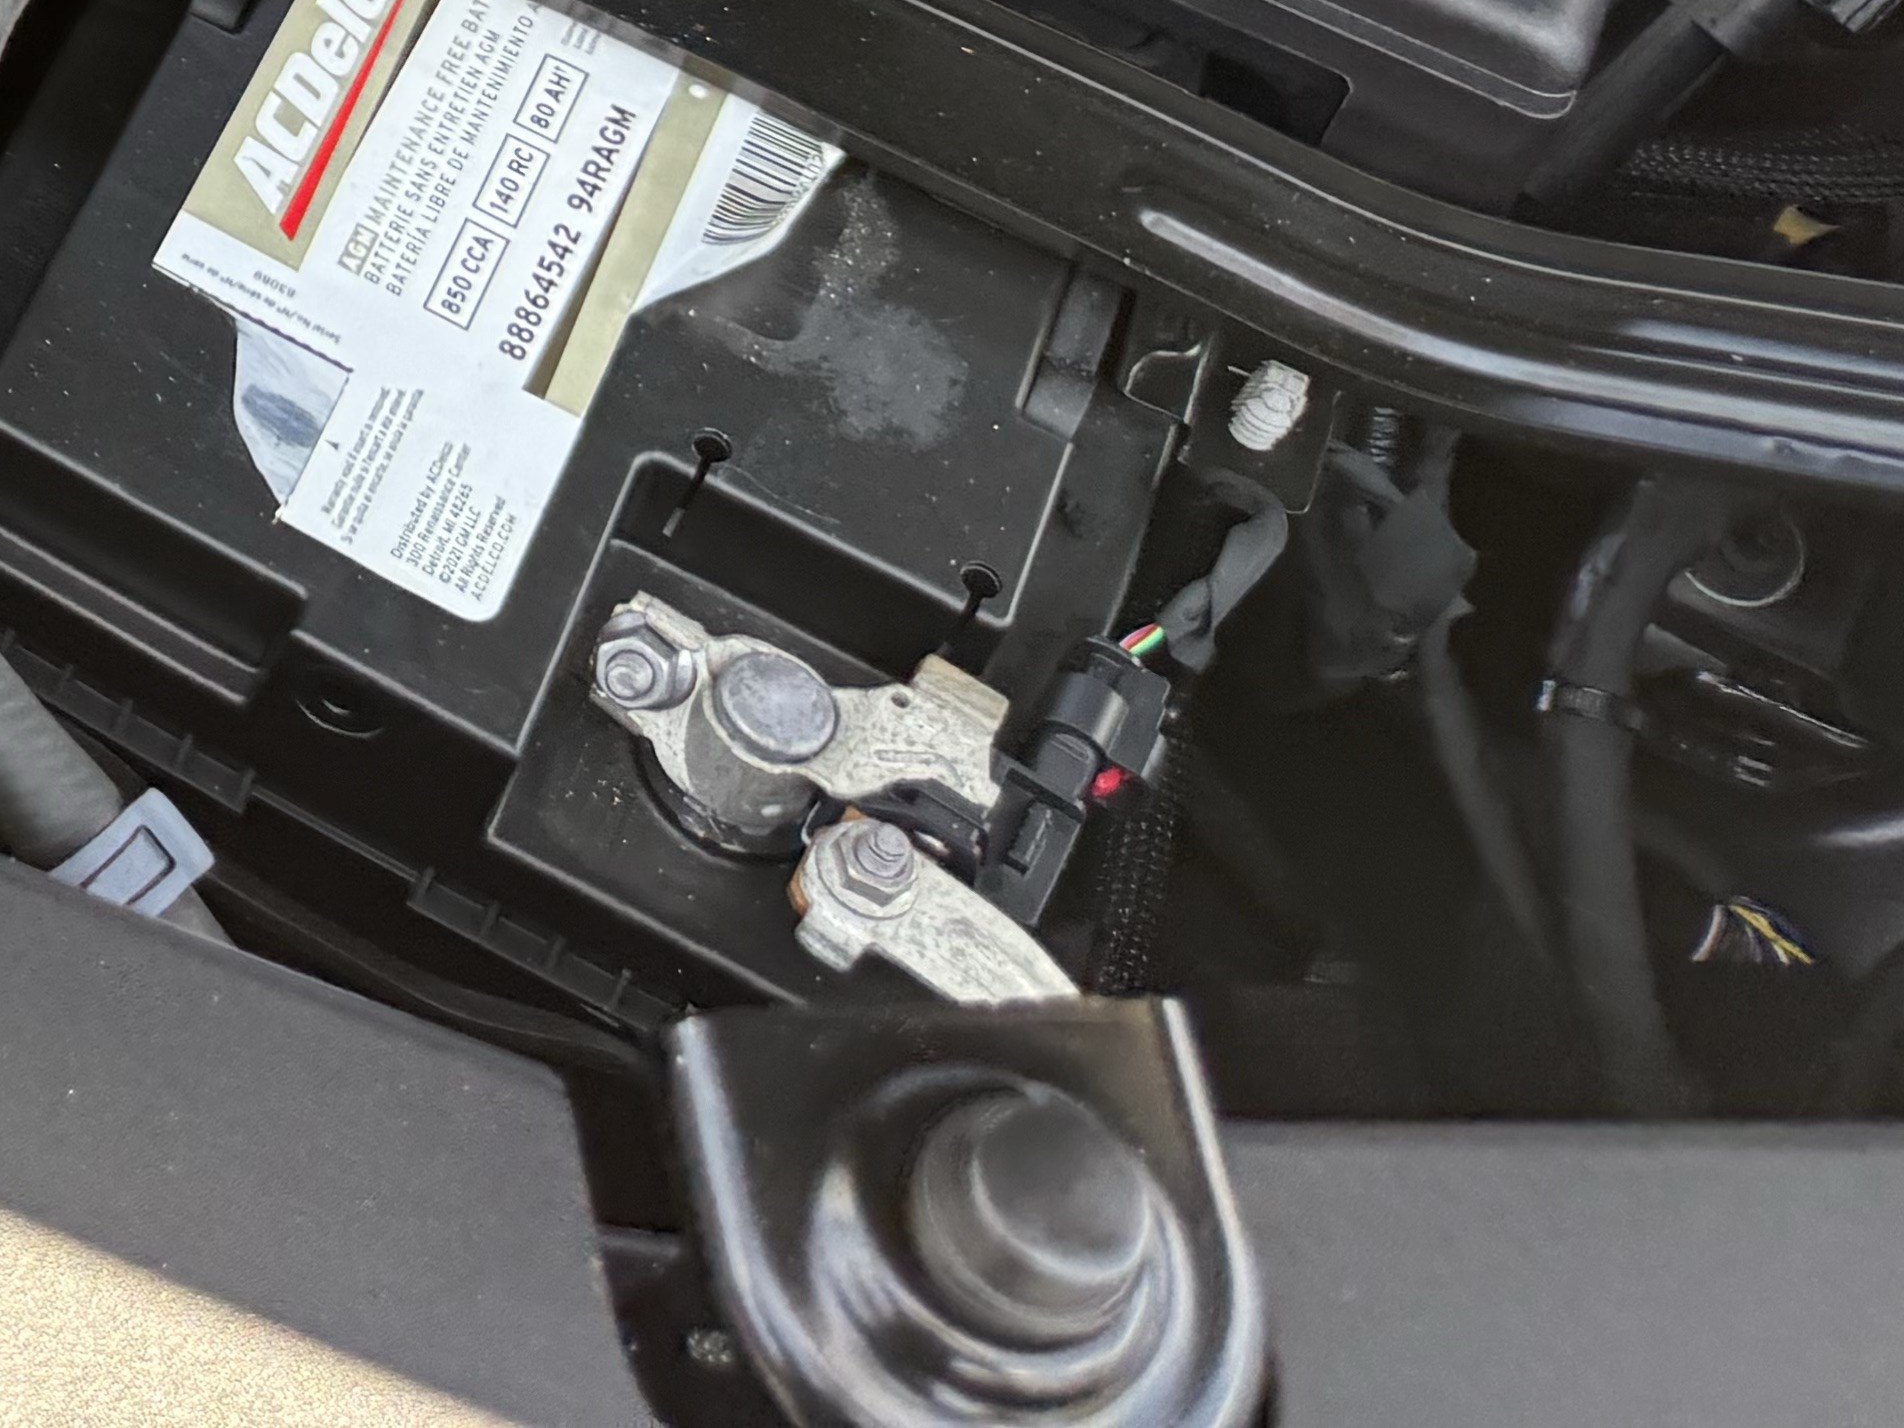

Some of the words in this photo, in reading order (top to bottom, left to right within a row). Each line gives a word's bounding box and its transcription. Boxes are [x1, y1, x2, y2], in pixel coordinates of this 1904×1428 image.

[530, 100, 556, 131] 80
[337, 222, 376, 272] AGM
[363, 86, 446, 225] MAINTENANCE
[434, 33, 472, 85] FREE
[362, 202, 414, 284] BATTERIE
[404, 155, 437, 202] SANS
[427, 64, 483, 156] ENTRETIEN
[474, 27, 502, 65] AGM
[382, 220, 431, 296] BATERÍA
[420, 171, 456, 223] LIBRE
[447, 146, 469, 171] DE
[459, 13, 536, 146] MANTENIMIENTO
[487, 174, 520, 215] 140
[506, 144, 534, 177] RC
[497, 220, 582, 362] 88864542
[563, 101, 637, 216] 94RAGM
[439, 272, 471, 314] 850
[457, 228, 491, 274] CCA
[390, 497, 427, 558] Distributed
[418, 482, 436, 501] by
[405, 540, 425, 567] 300
[416, 475, 456, 542] Renaissance
[447, 441, 472, 477] Center
[441, 517, 456, 533] MI
[454, 527, 471, 547] GM
[462, 505, 481, 528] LLC
[475, 494, 506, 543] Reserved
[453, 575, 469, 592] All
[458, 541, 487, 579] Rights
[468, 512, 519, 600] ACDELCO.COM
